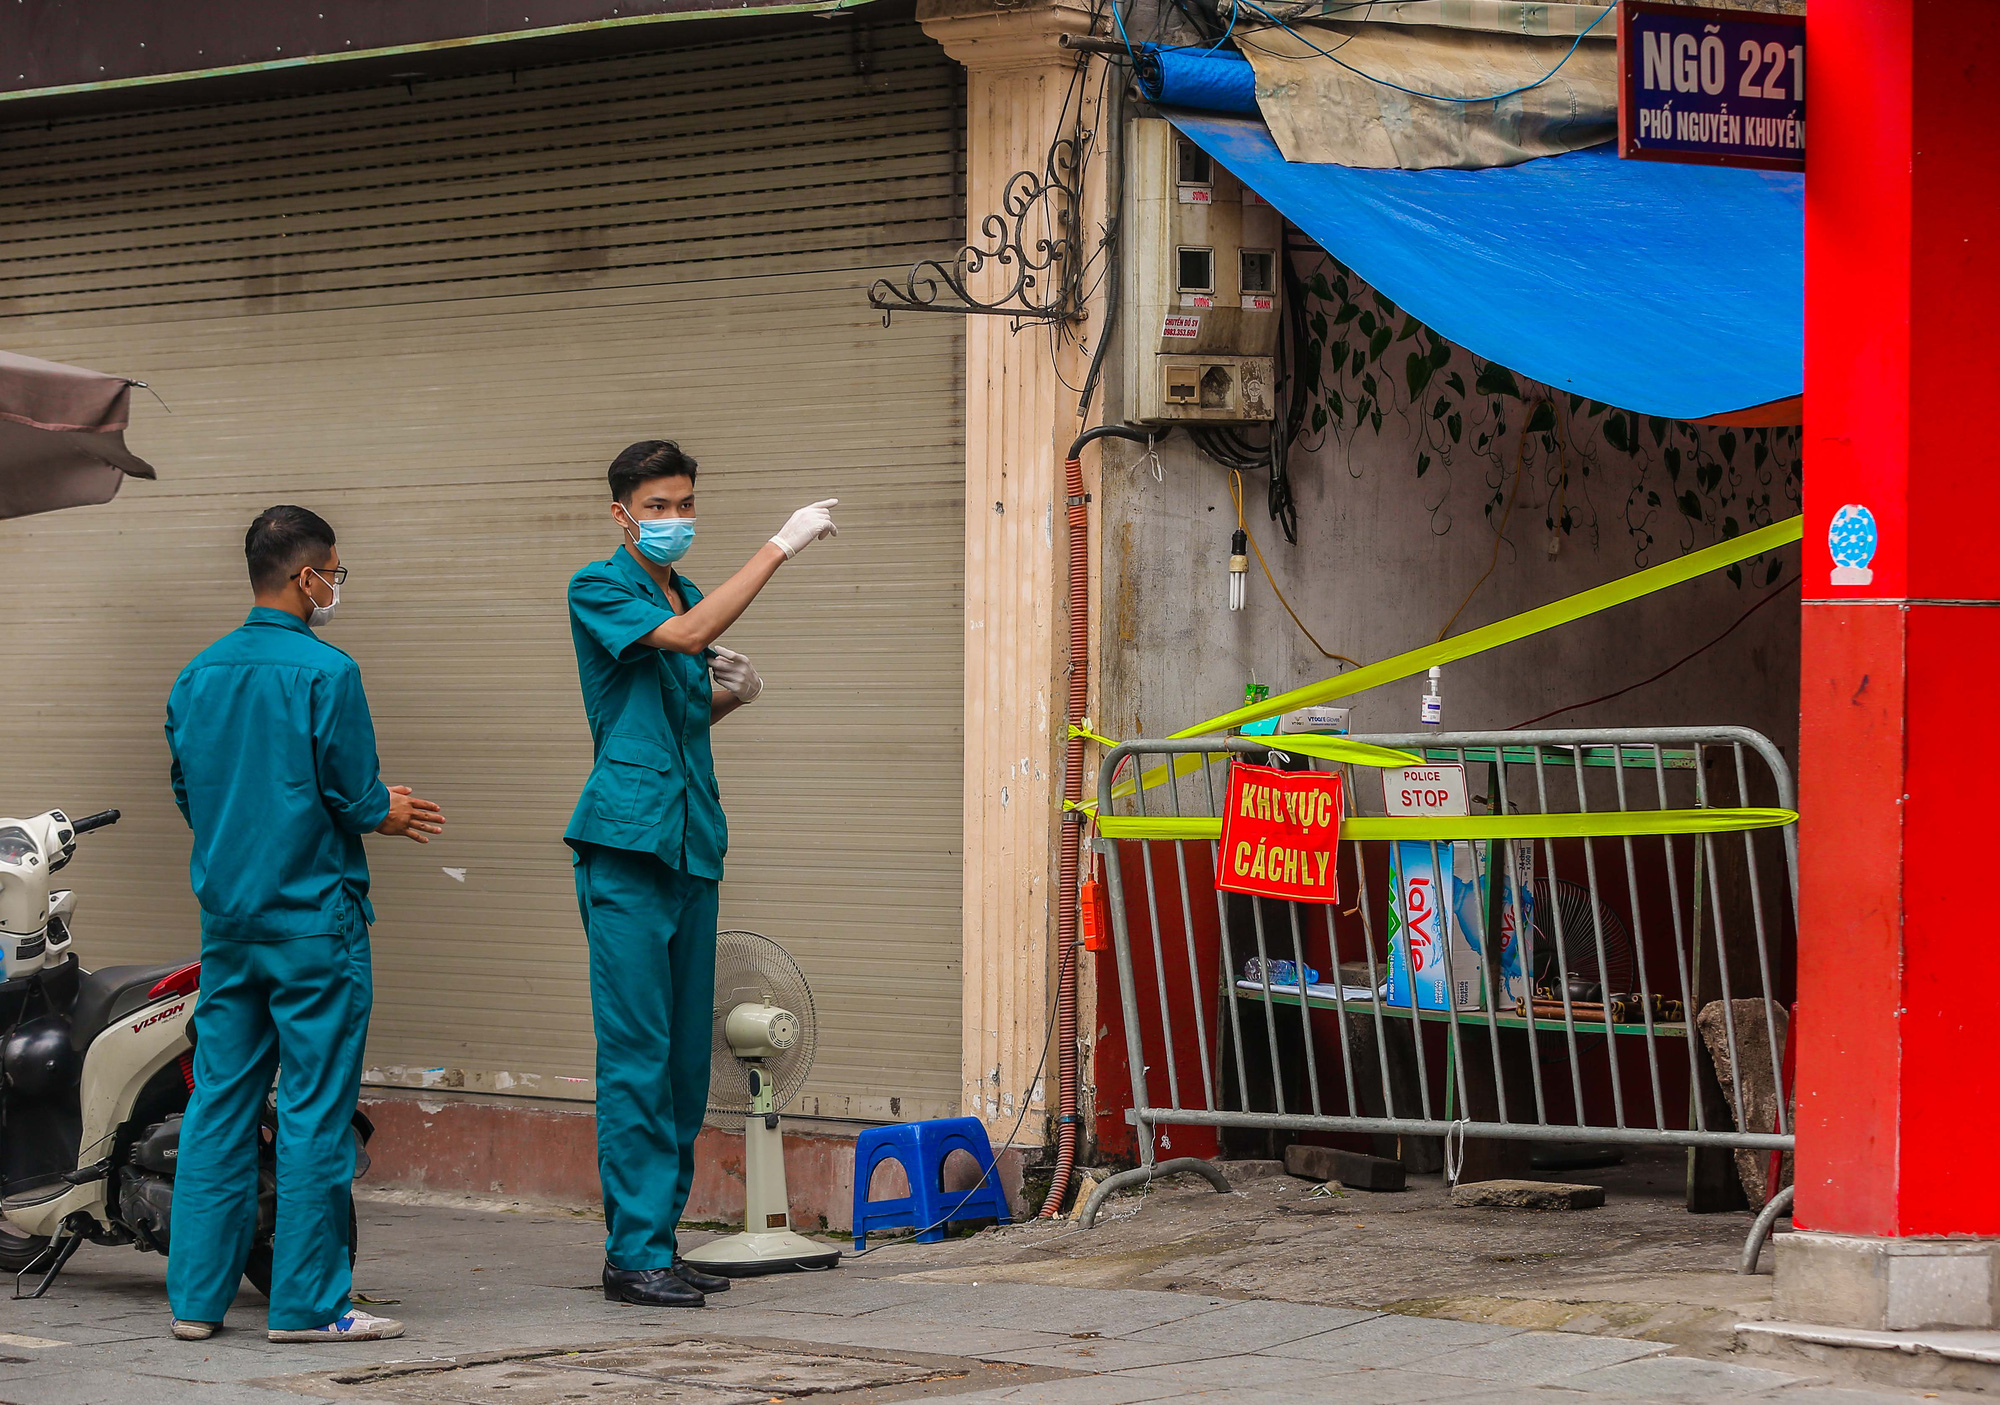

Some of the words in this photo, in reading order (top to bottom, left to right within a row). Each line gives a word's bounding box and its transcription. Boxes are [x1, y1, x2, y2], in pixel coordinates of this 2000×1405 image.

[1642, 24, 1725, 96] NGÕ
[1738, 40, 1804, 101] 221
[1639, 99, 1673, 140] PHỐ
[1676, 103, 1741, 145] NGUYỄN
[1744, 109, 1806, 149] KHUYẾN
[1403, 771, 1441, 782] POLICE
[1401, 789, 1450, 808] STOP
[1234, 837, 1298, 884] CÁCH
[1300, 851, 1330, 887] LY
[131, 1002, 185, 1034] VISION
